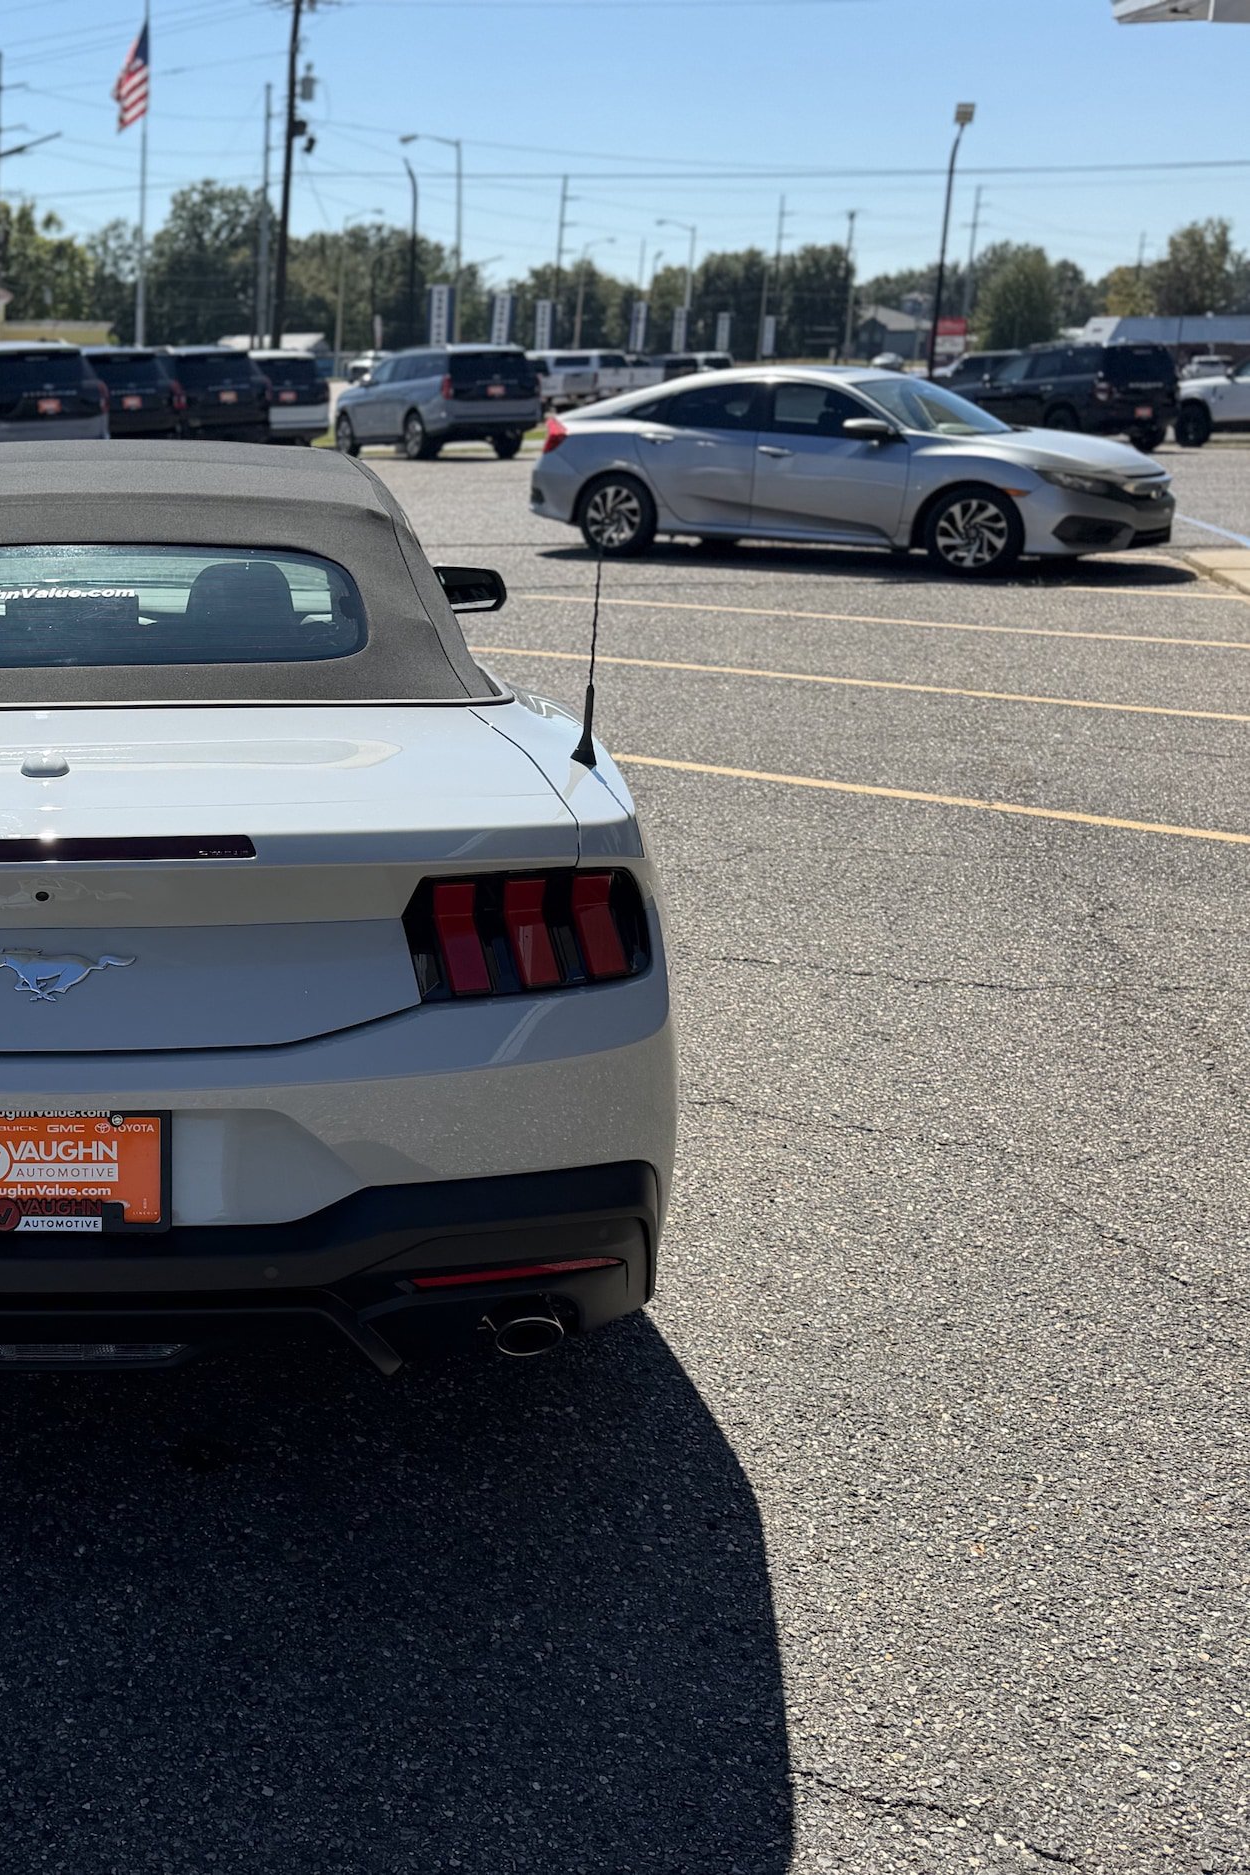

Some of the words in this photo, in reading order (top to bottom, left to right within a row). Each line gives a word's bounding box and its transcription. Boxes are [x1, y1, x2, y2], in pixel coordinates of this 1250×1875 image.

[46, 1124, 86, 1133] GMC
[6, 1140, 118, 1161] VAUGHN
[16, 1167, 115, 1178] AUTOMOTIVE
[17, 1198, 102, 1215] VAUGHN
[23, 1220, 100, 1229] AUTOMOTIVE
